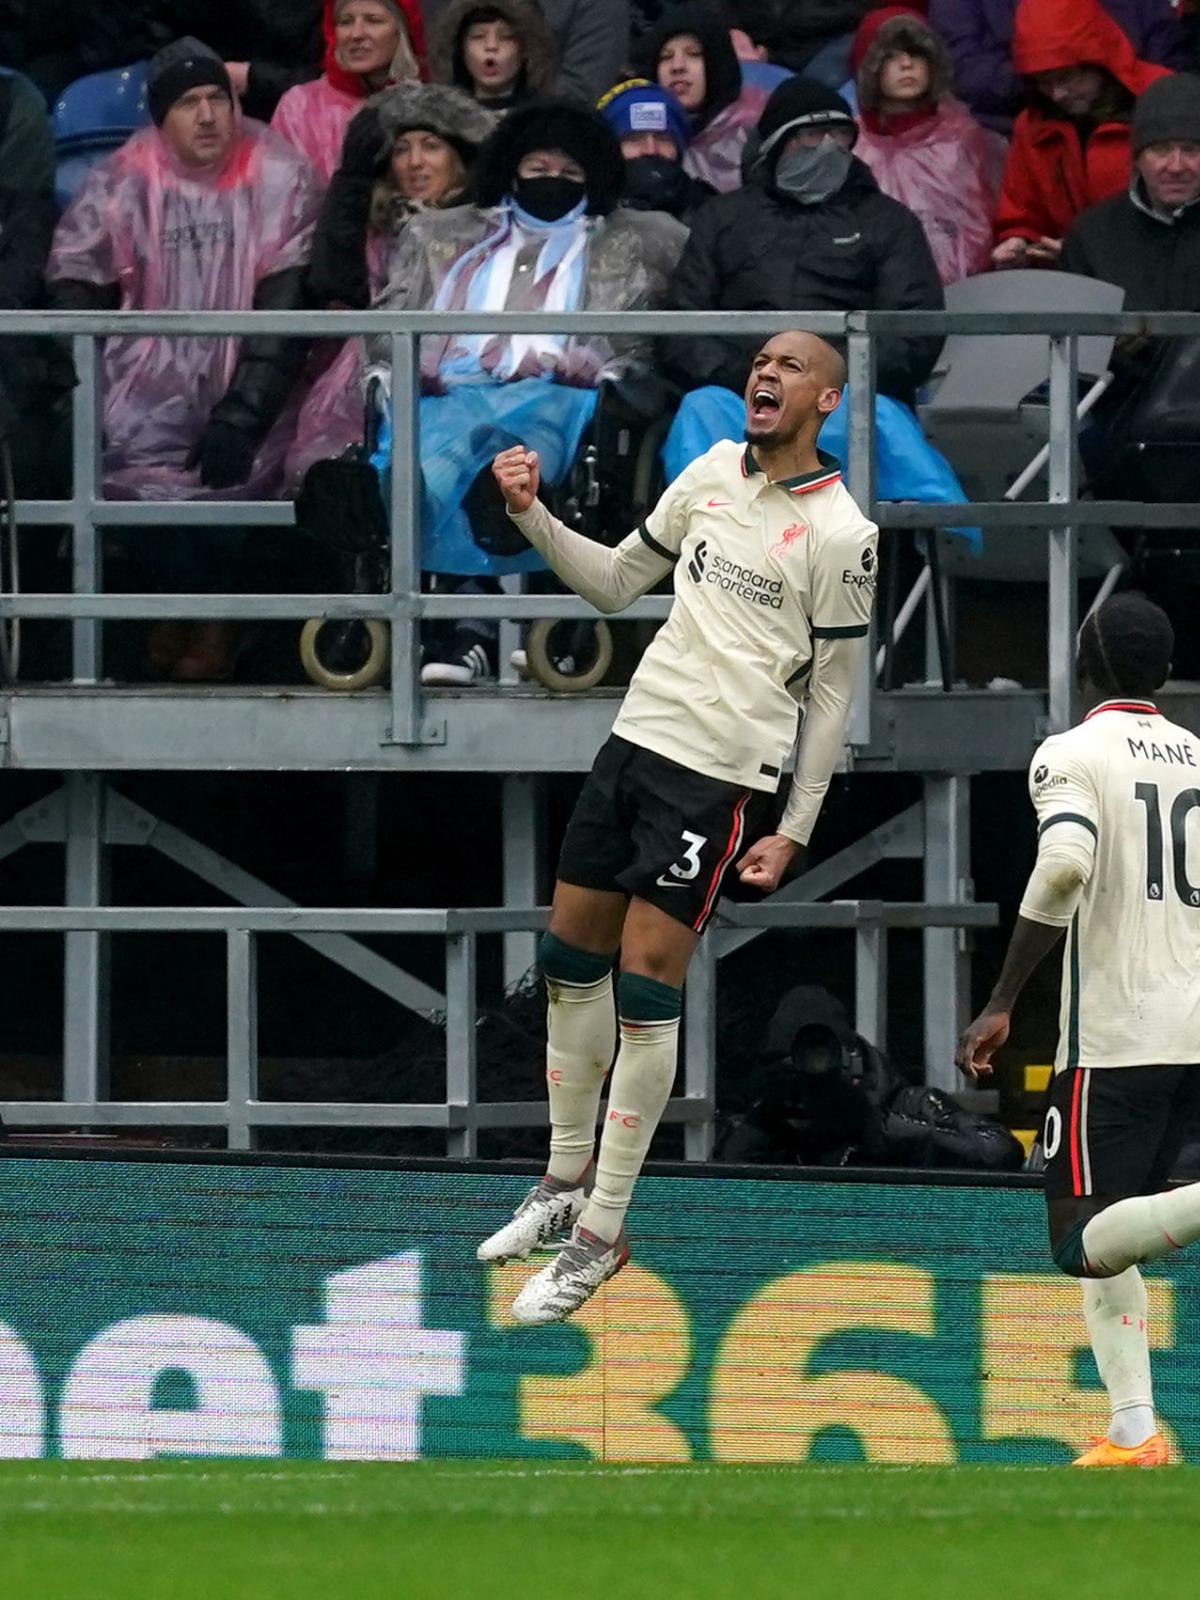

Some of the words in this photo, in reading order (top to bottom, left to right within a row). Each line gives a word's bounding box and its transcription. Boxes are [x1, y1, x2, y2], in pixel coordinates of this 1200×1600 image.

[705, 570, 784, 610] chartered
[711, 555, 784, 595] standard
[1126, 738, 1198, 768] MANÉ
[668, 829, 708, 880] 3
